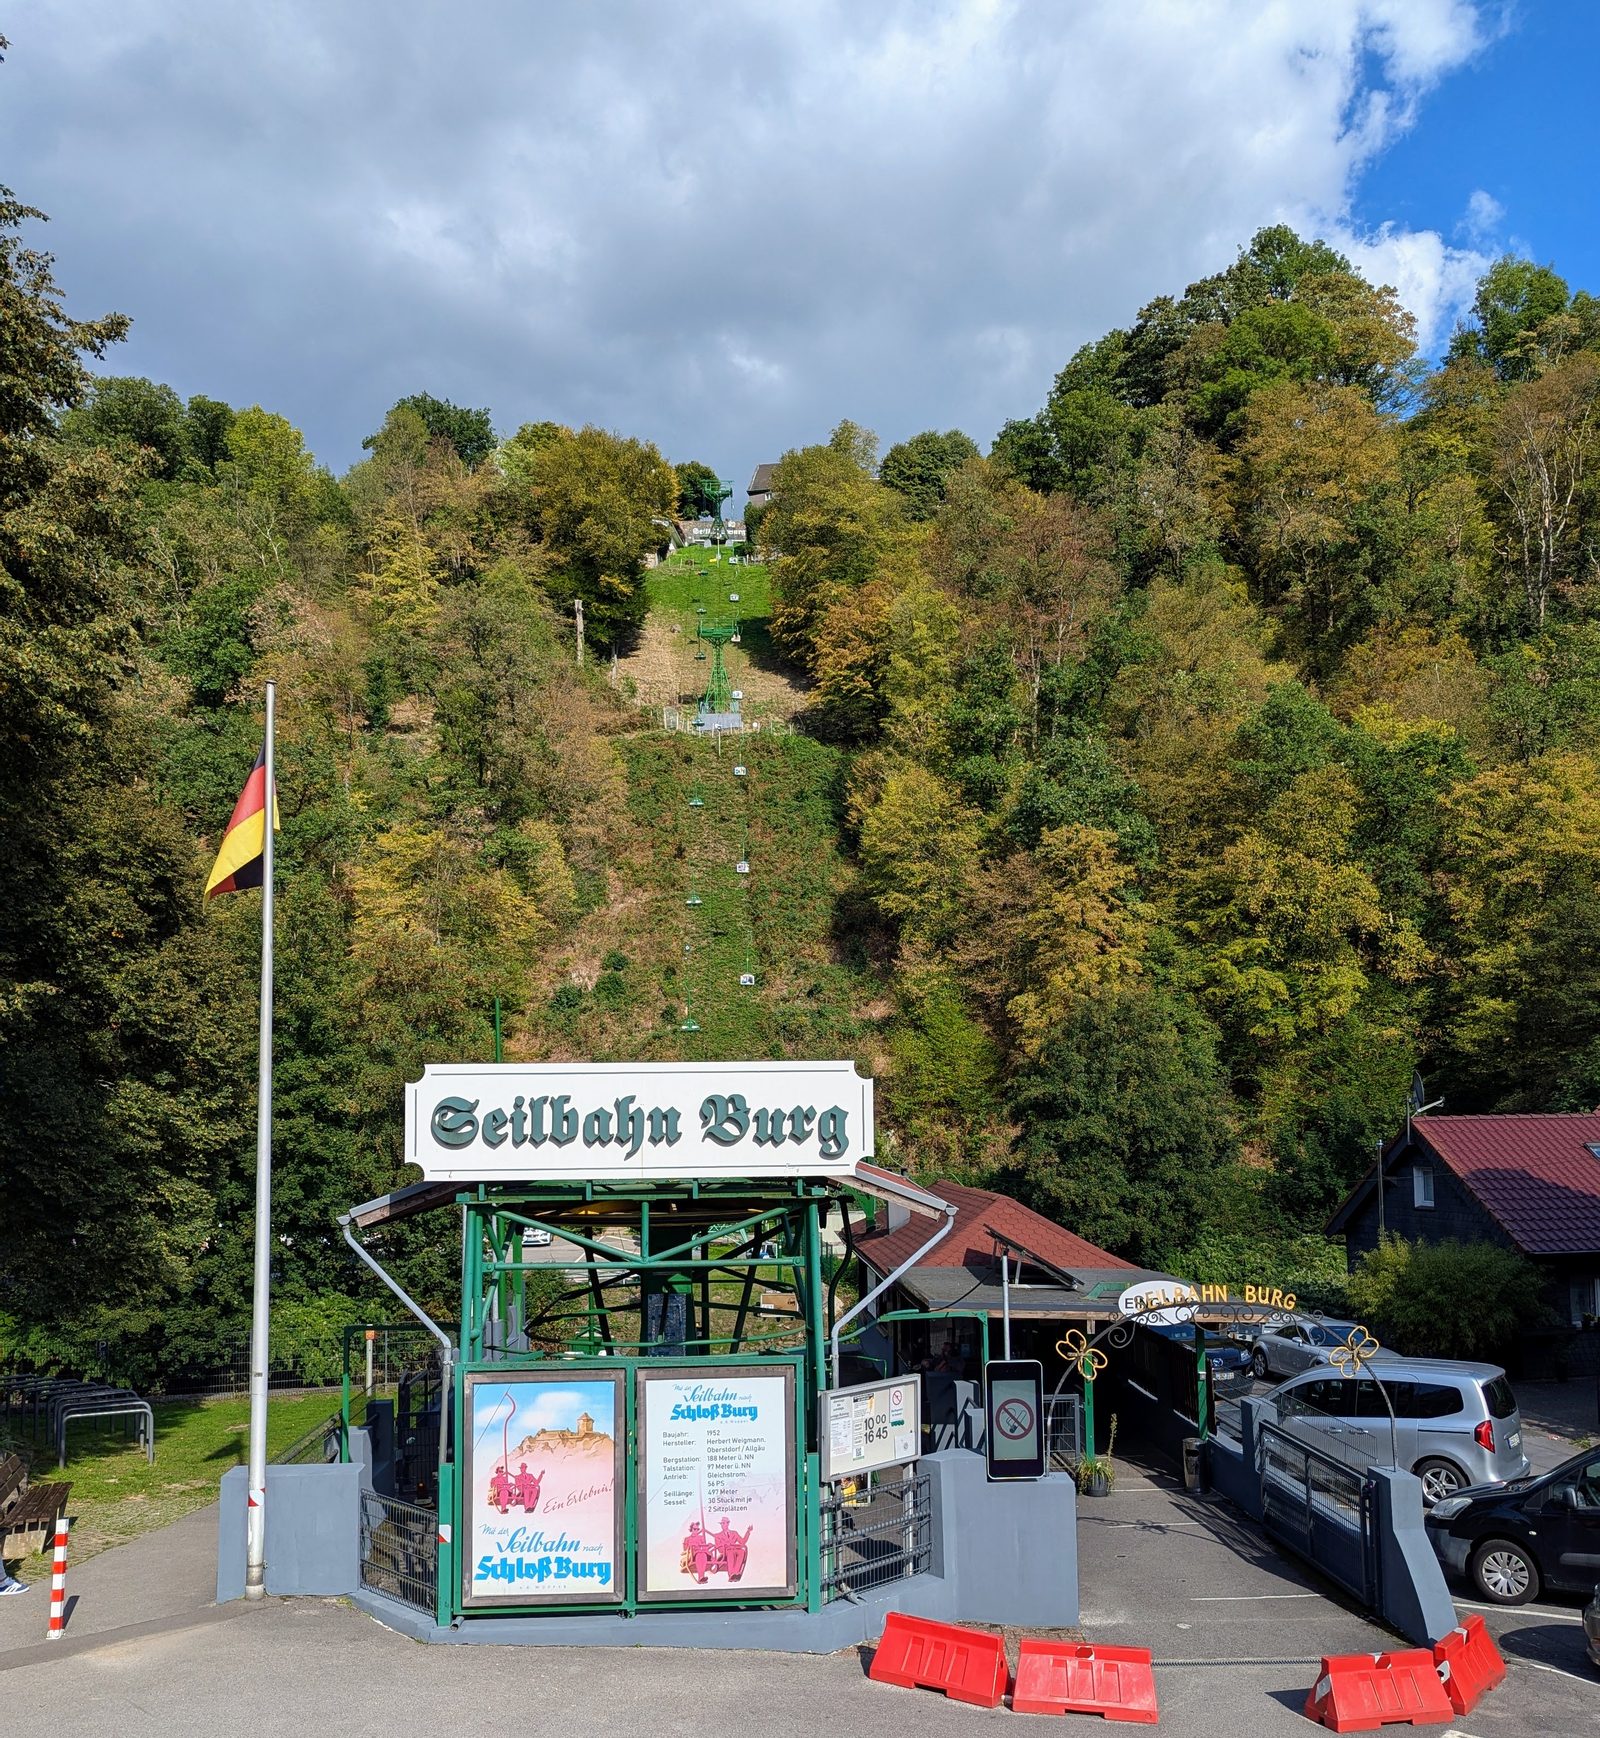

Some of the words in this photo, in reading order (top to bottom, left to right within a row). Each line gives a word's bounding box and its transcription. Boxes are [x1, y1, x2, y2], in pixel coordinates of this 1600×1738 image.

[430, 1094, 683, 1161] Seilbahn
[699, 1093, 850, 1160] Burg
[1134, 1285, 1228, 1313] SEILBAHN
[1245, 1285, 1297, 1310] BURG
[683, 1384, 738, 1402] Seilbahn
[670, 1403, 720, 1422] Schloß
[720, 1403, 758, 1422] Burg
[864, 1417, 874, 1431] 10
[875, 1414, 886, 1424] 00
[864, 1430, 874, 1444] 16
[875, 1426, 888, 1440] 45
[663, 1490, 694, 1498] Seillänge:
[746, 1496, 752, 1504] je
[543, 1496, 564, 1513] Ein
[712, 1505, 748, 1513] Sitzplätzen
[495, 1526, 581, 1553] Seilbahn
[582, 1543, 603, 1555] nach
[474, 1555, 553, 1584] Schloß
[553, 1556, 612, 1585] Burg
